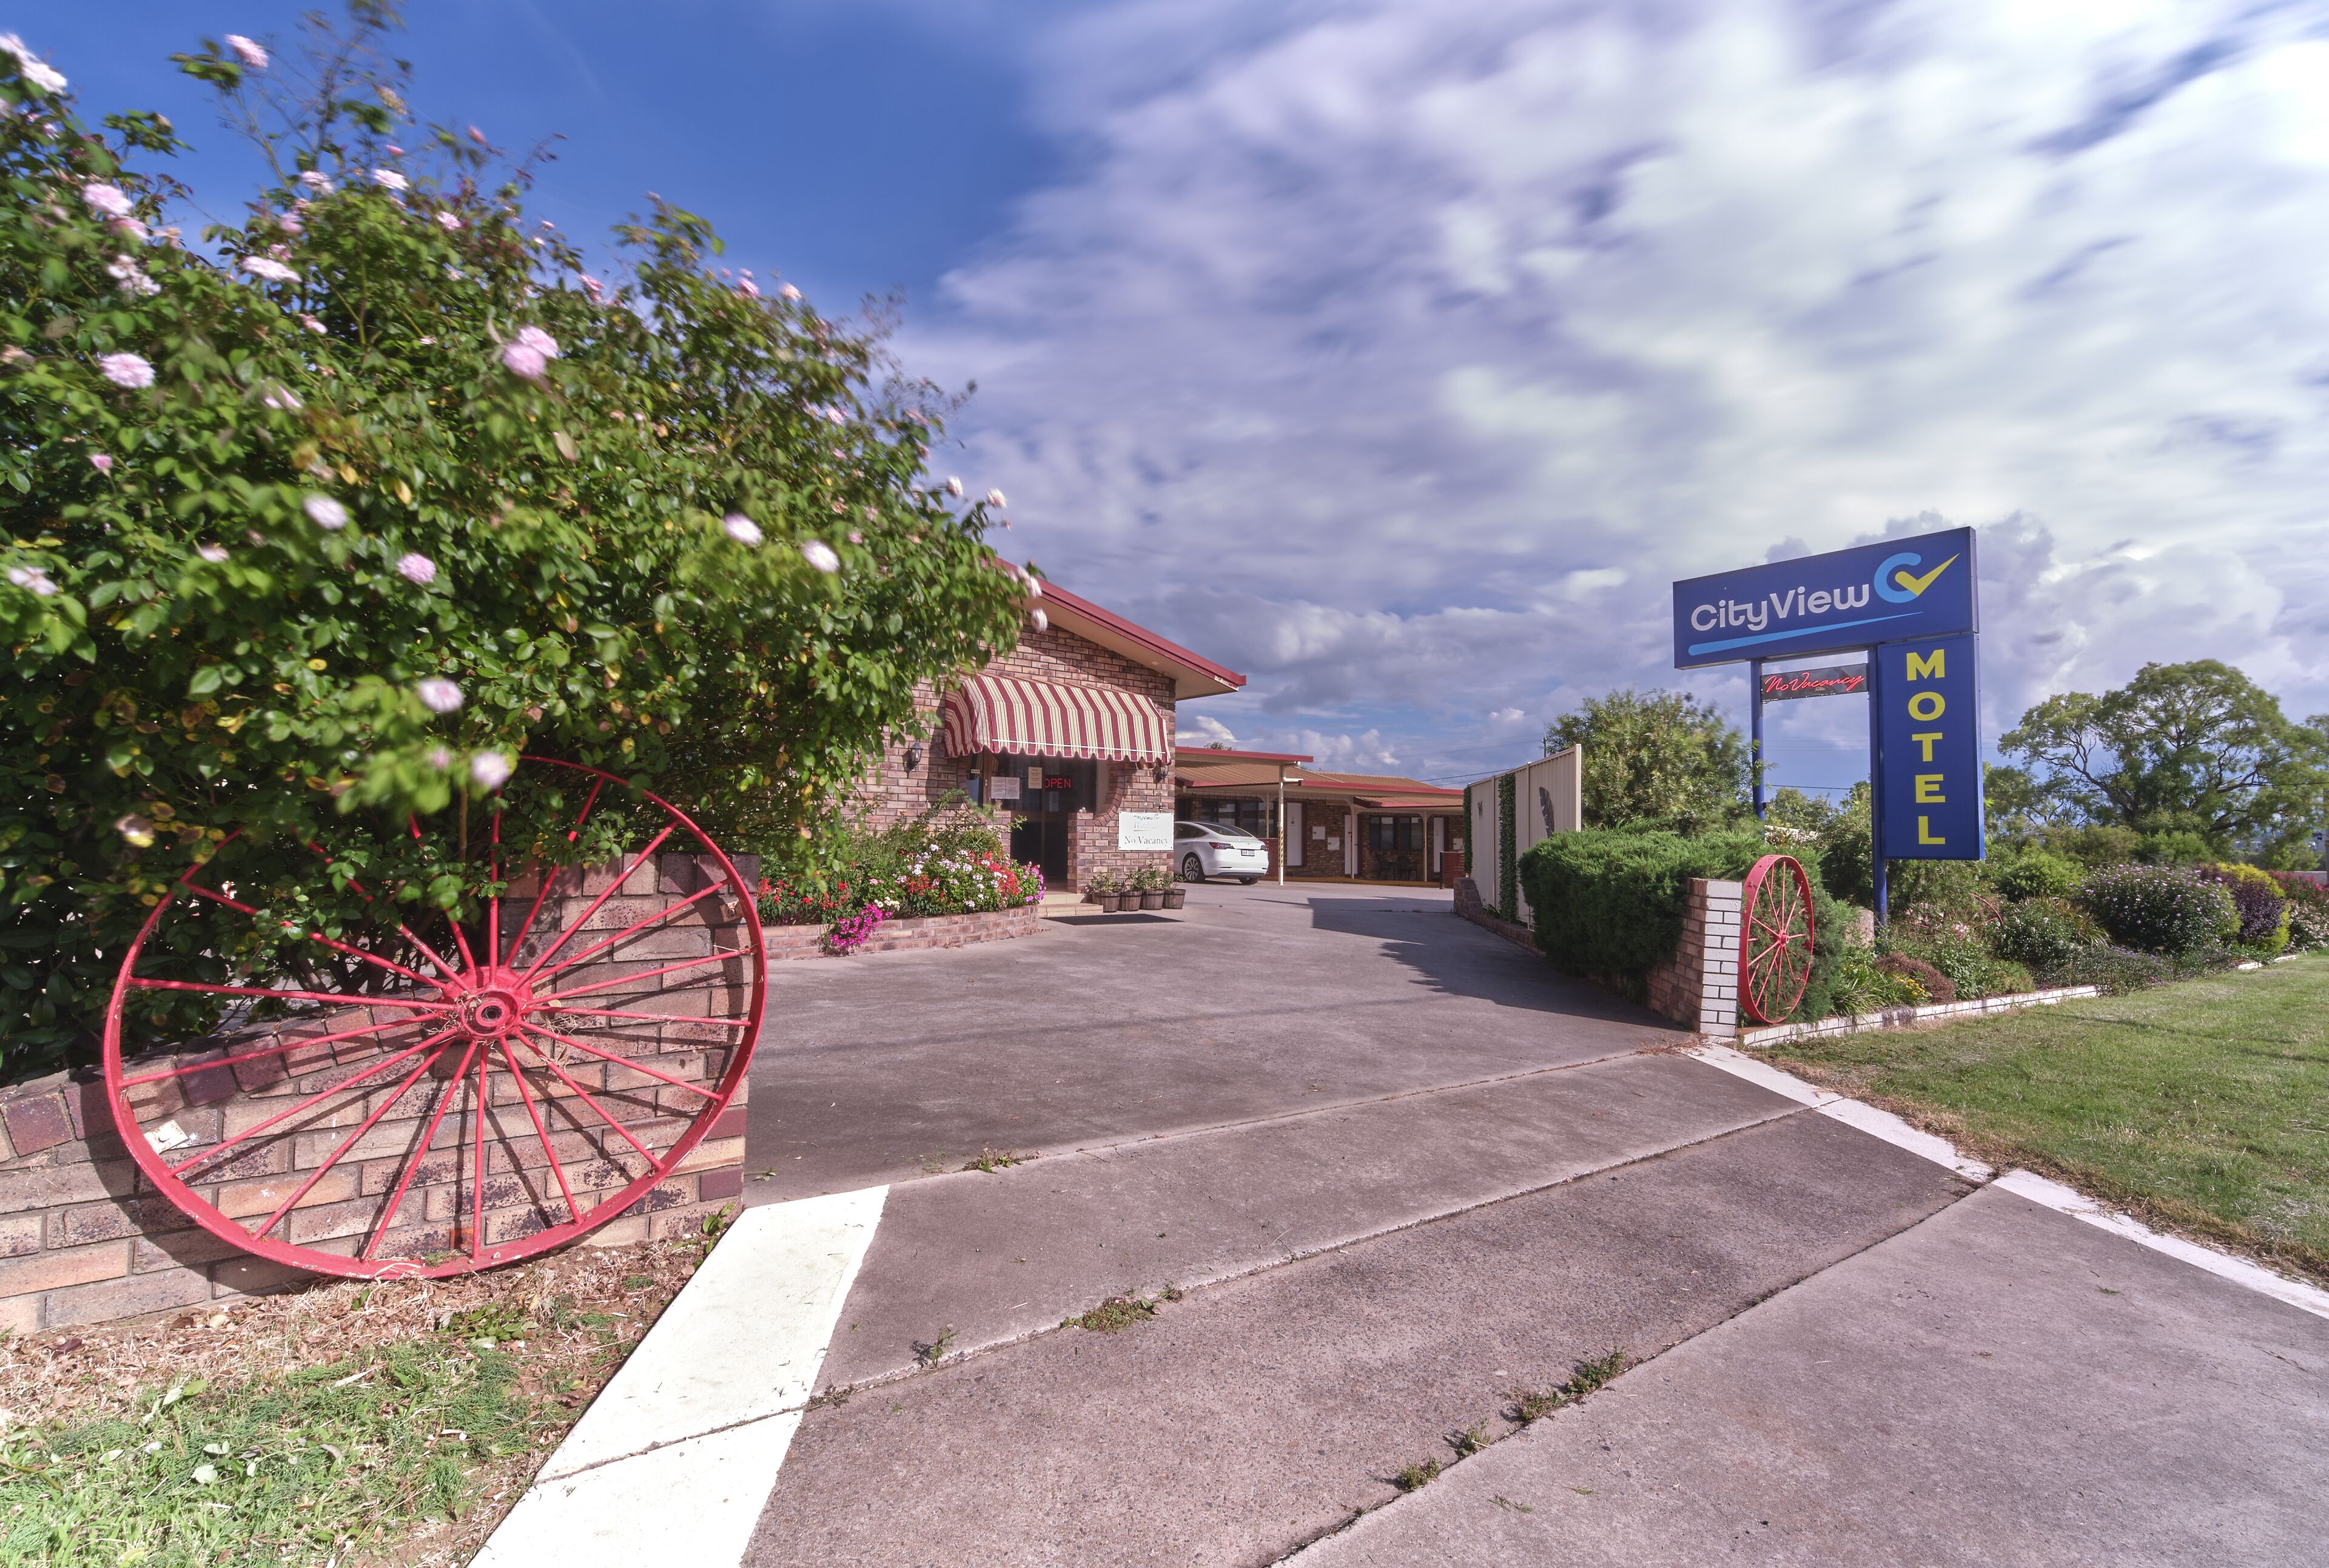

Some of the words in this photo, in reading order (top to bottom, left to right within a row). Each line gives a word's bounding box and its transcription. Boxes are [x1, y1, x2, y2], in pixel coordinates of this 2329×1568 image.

[1691, 584, 1870, 631] CityView
[1765, 675, 1789, 693] No
[1789, 672, 1864, 691] Vacancy
[1906, 649, 1946, 844] MOTEL
[1044, 778, 1071, 788] OPEN
[1138, 836, 1168, 846] Vacancy
